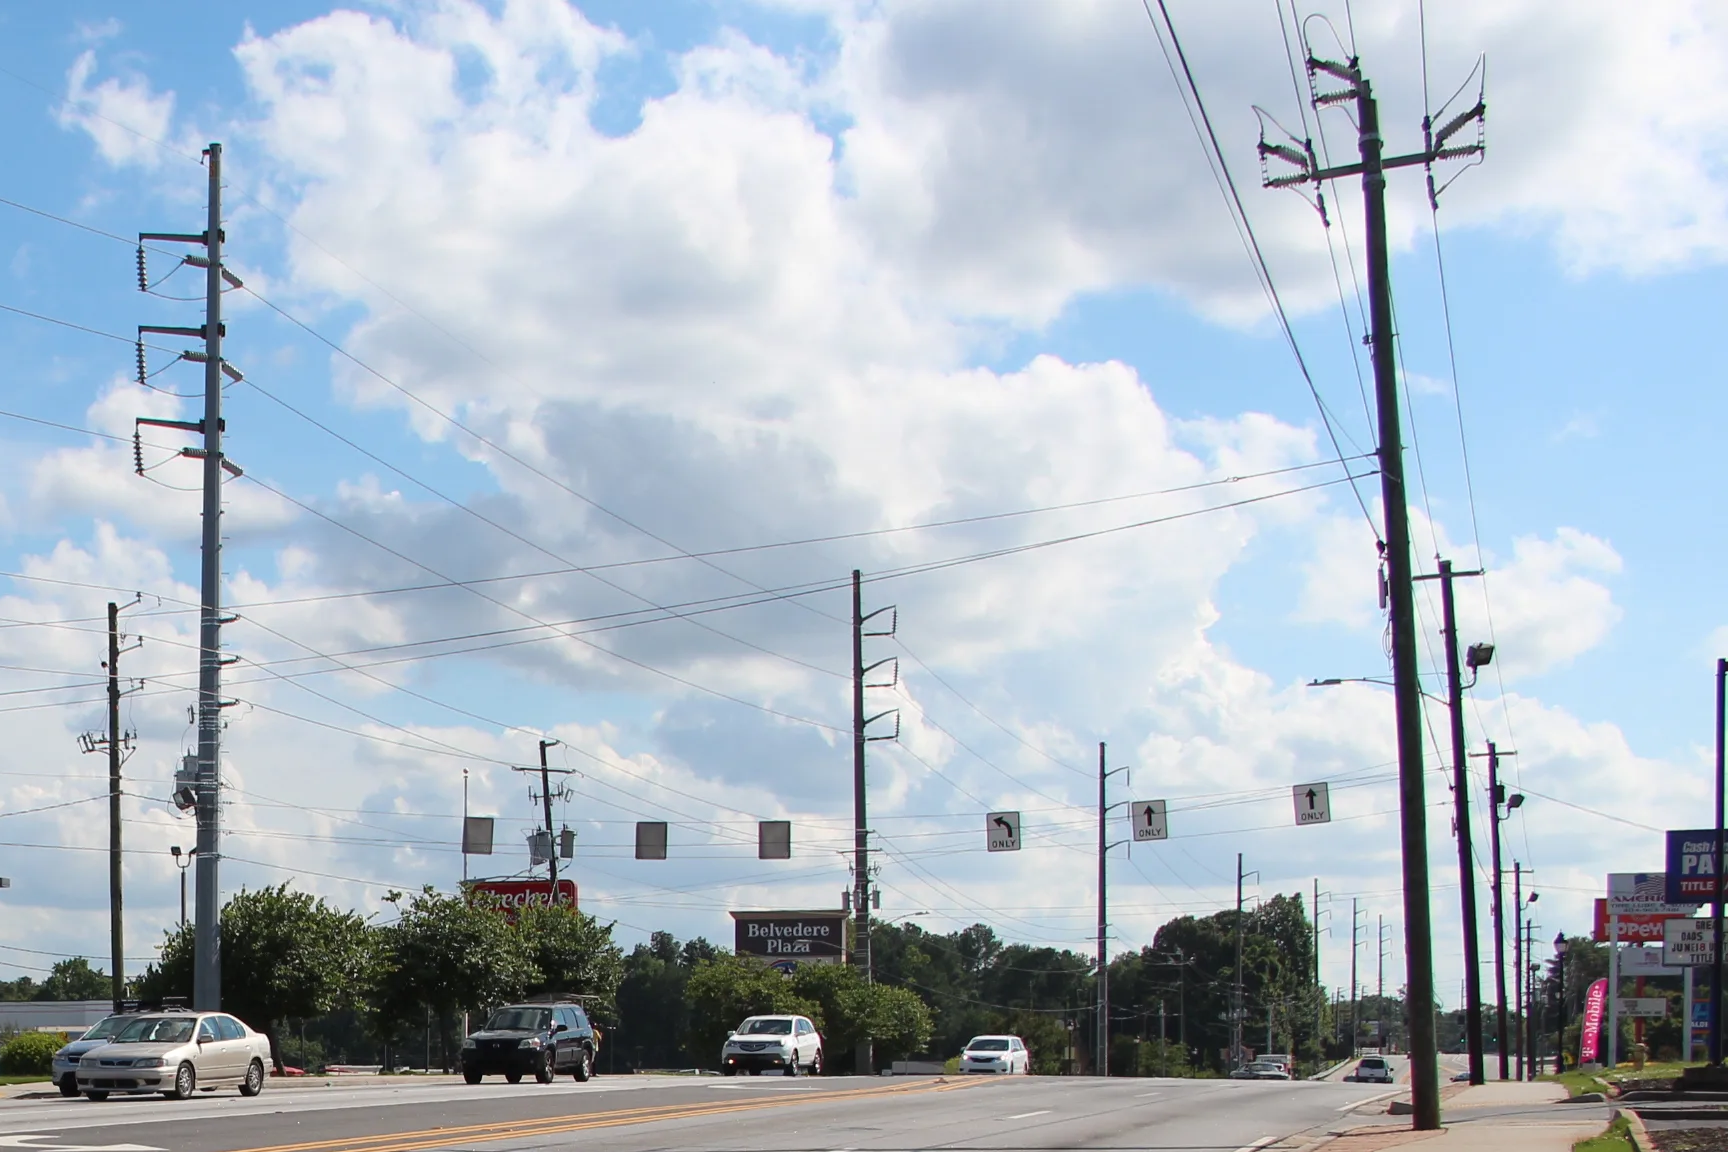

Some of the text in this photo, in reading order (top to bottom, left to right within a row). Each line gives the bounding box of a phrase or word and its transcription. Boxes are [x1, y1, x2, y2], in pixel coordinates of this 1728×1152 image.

[1300, 811, 1325, 821] ONLY
[1138, 828, 1163, 838] ONLY
[991, 839, 1016, 849] ONLY
[1683, 841, 1710, 853] Cash
[1682, 854, 1728, 875] PA
[1680, 881, 1714, 891] TITLE
[747, 922, 830, 938] Belvedere
[1681, 932, 1703, 941] DADS
[767, 939, 811, 953] Plaza
[1690, 954, 1713, 963] TITLE
